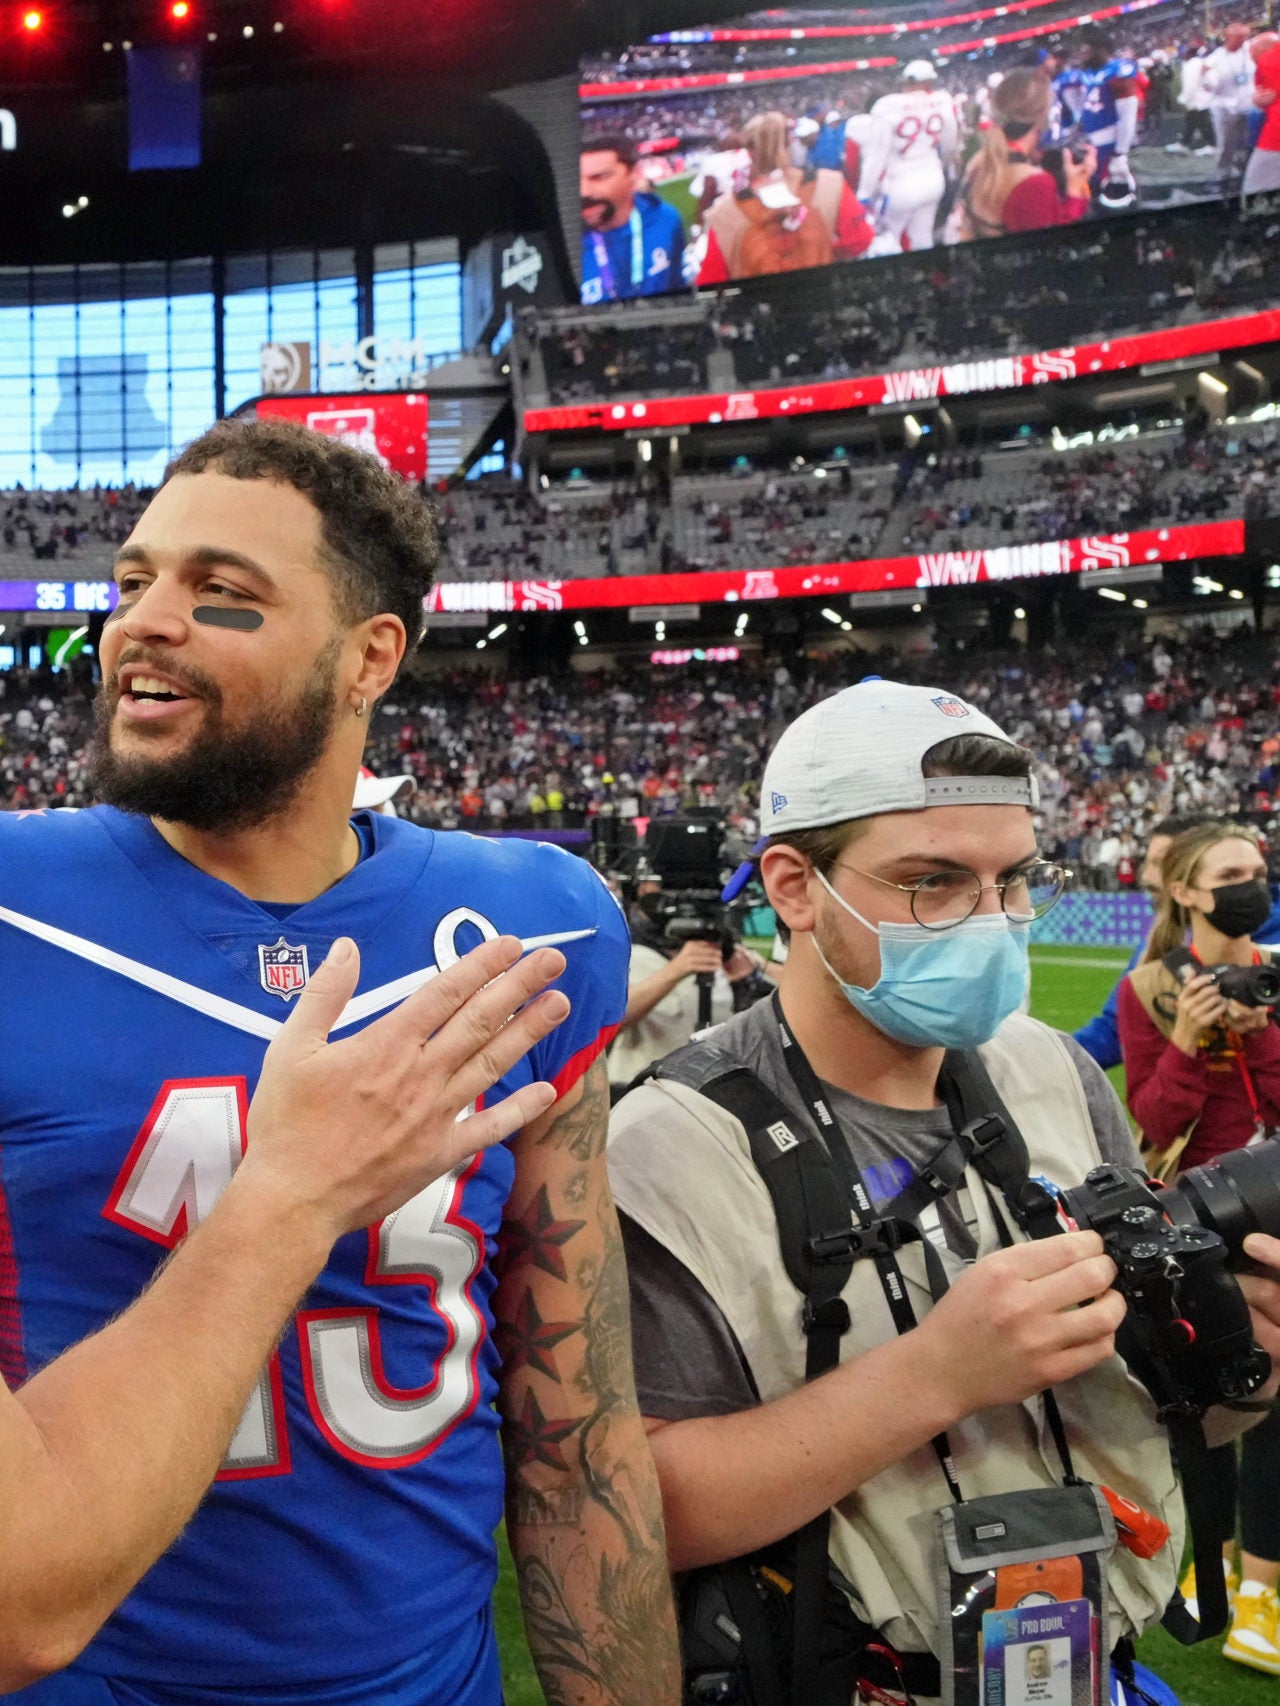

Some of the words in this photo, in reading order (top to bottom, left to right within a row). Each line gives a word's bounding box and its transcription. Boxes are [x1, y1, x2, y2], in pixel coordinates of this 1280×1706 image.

[36, 582, 66, 610] 35
[267, 965, 303, 990] NFL
[814, 1099, 833, 1126] think
[853, 1183, 870, 1211] think
[886, 1271, 904, 1300] think
